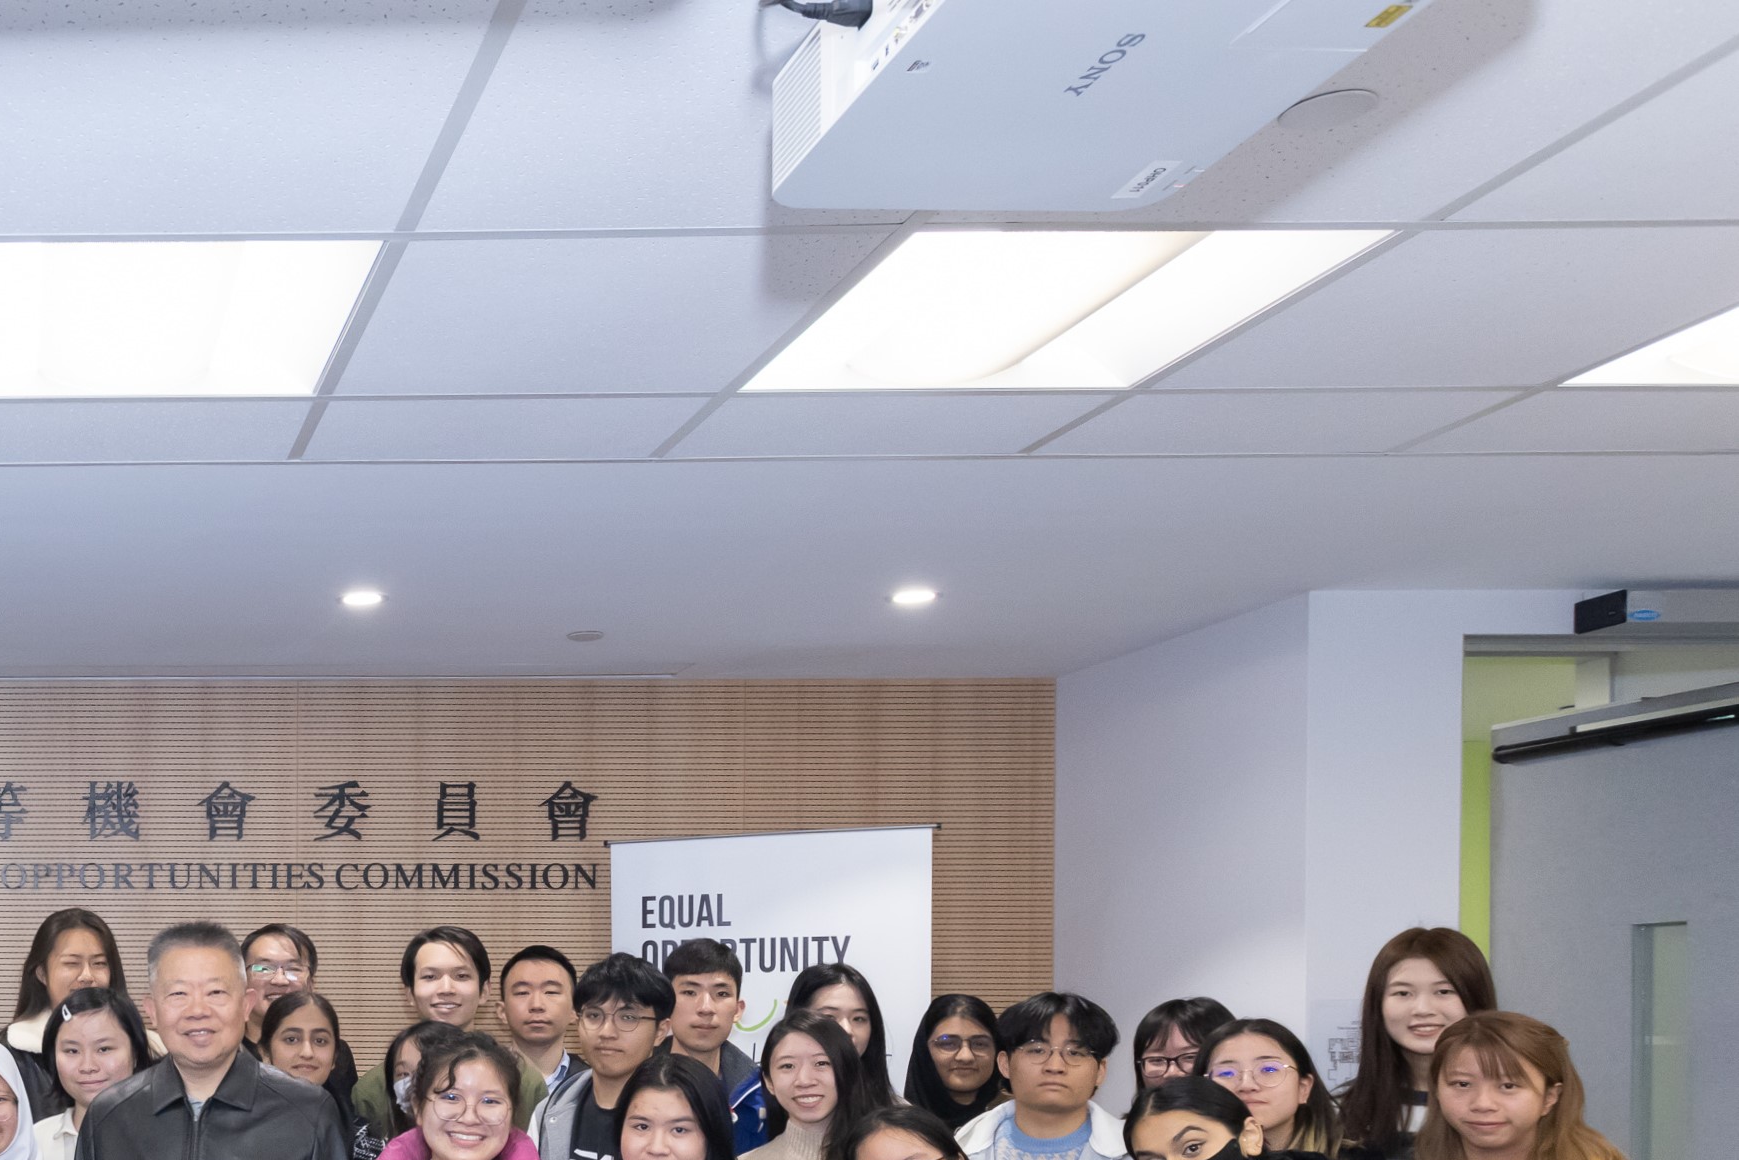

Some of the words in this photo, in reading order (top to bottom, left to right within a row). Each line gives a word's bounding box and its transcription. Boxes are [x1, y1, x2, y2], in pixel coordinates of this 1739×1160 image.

[1063, 33, 1146, 97] SONY
[0, 862, 325, 891] OPPORTUNITIES
[335, 862, 598, 891] COMMISSION
[641, 893, 732, 930] EQUAL
